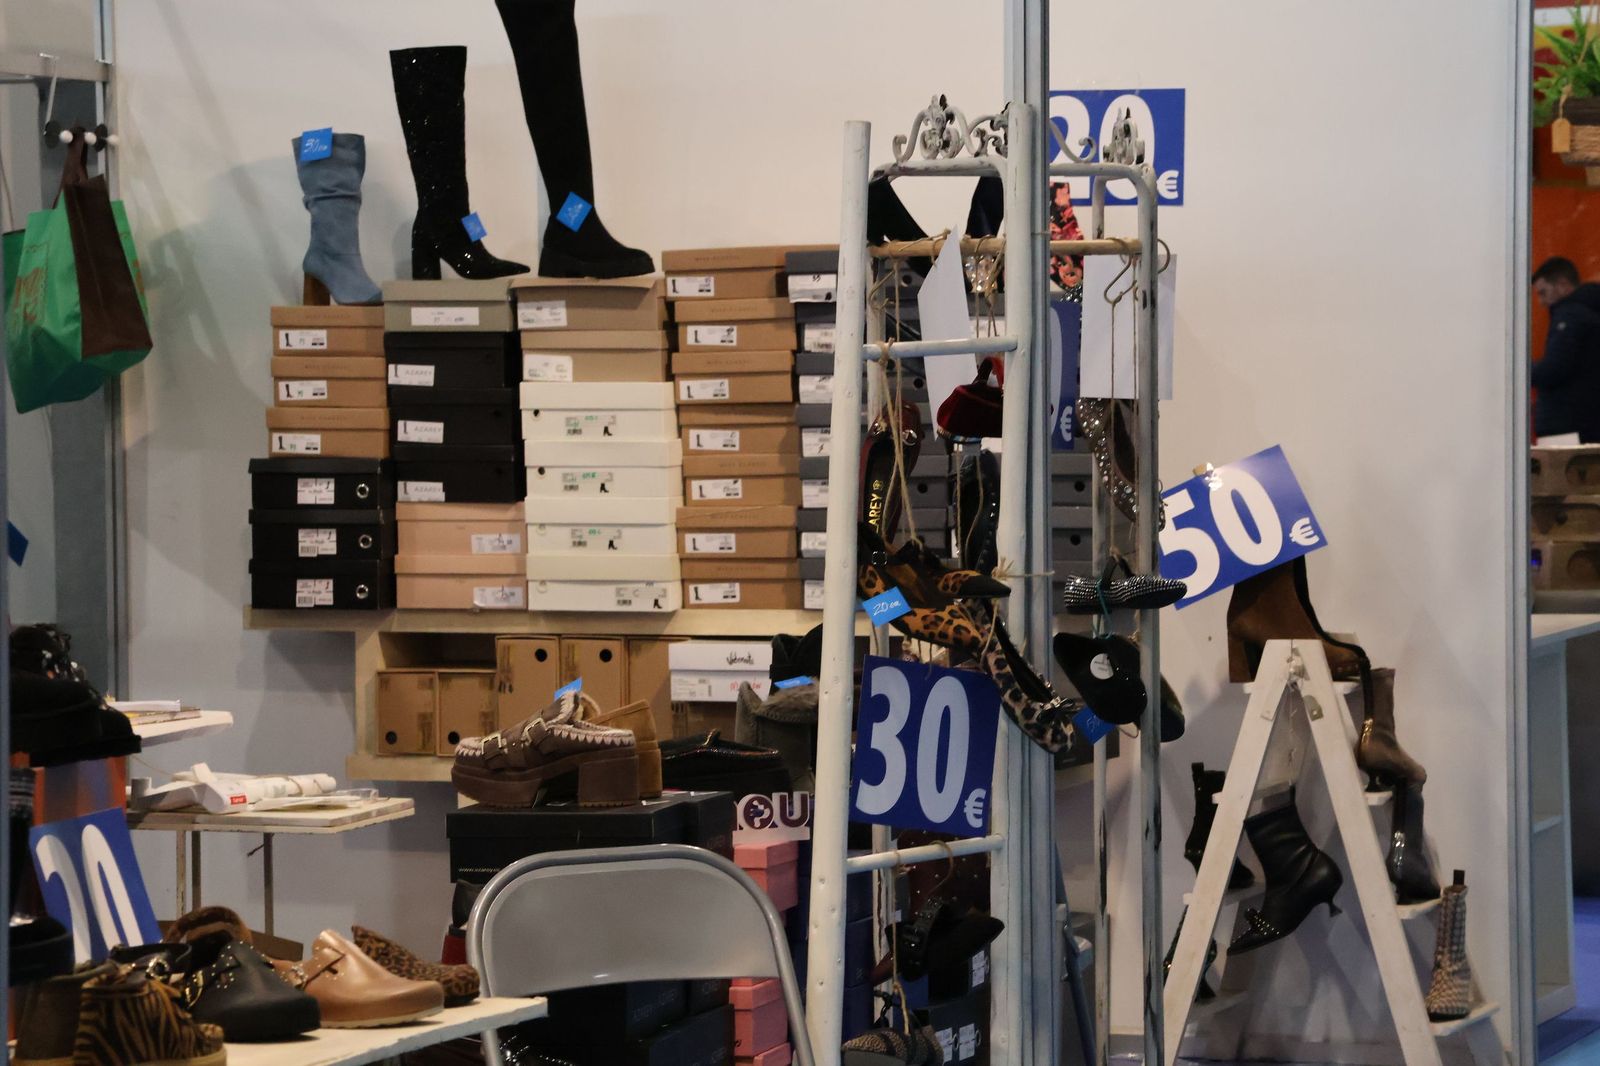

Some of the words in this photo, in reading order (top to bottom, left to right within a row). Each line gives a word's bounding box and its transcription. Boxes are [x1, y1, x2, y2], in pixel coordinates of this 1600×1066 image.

[1050, 94, 1179, 201] 20€
[1159, 468, 1320, 600] 50€
[733, 791, 809, 830] OU
[855, 665, 987, 829] 30€
[36, 824, 144, 968] 20
